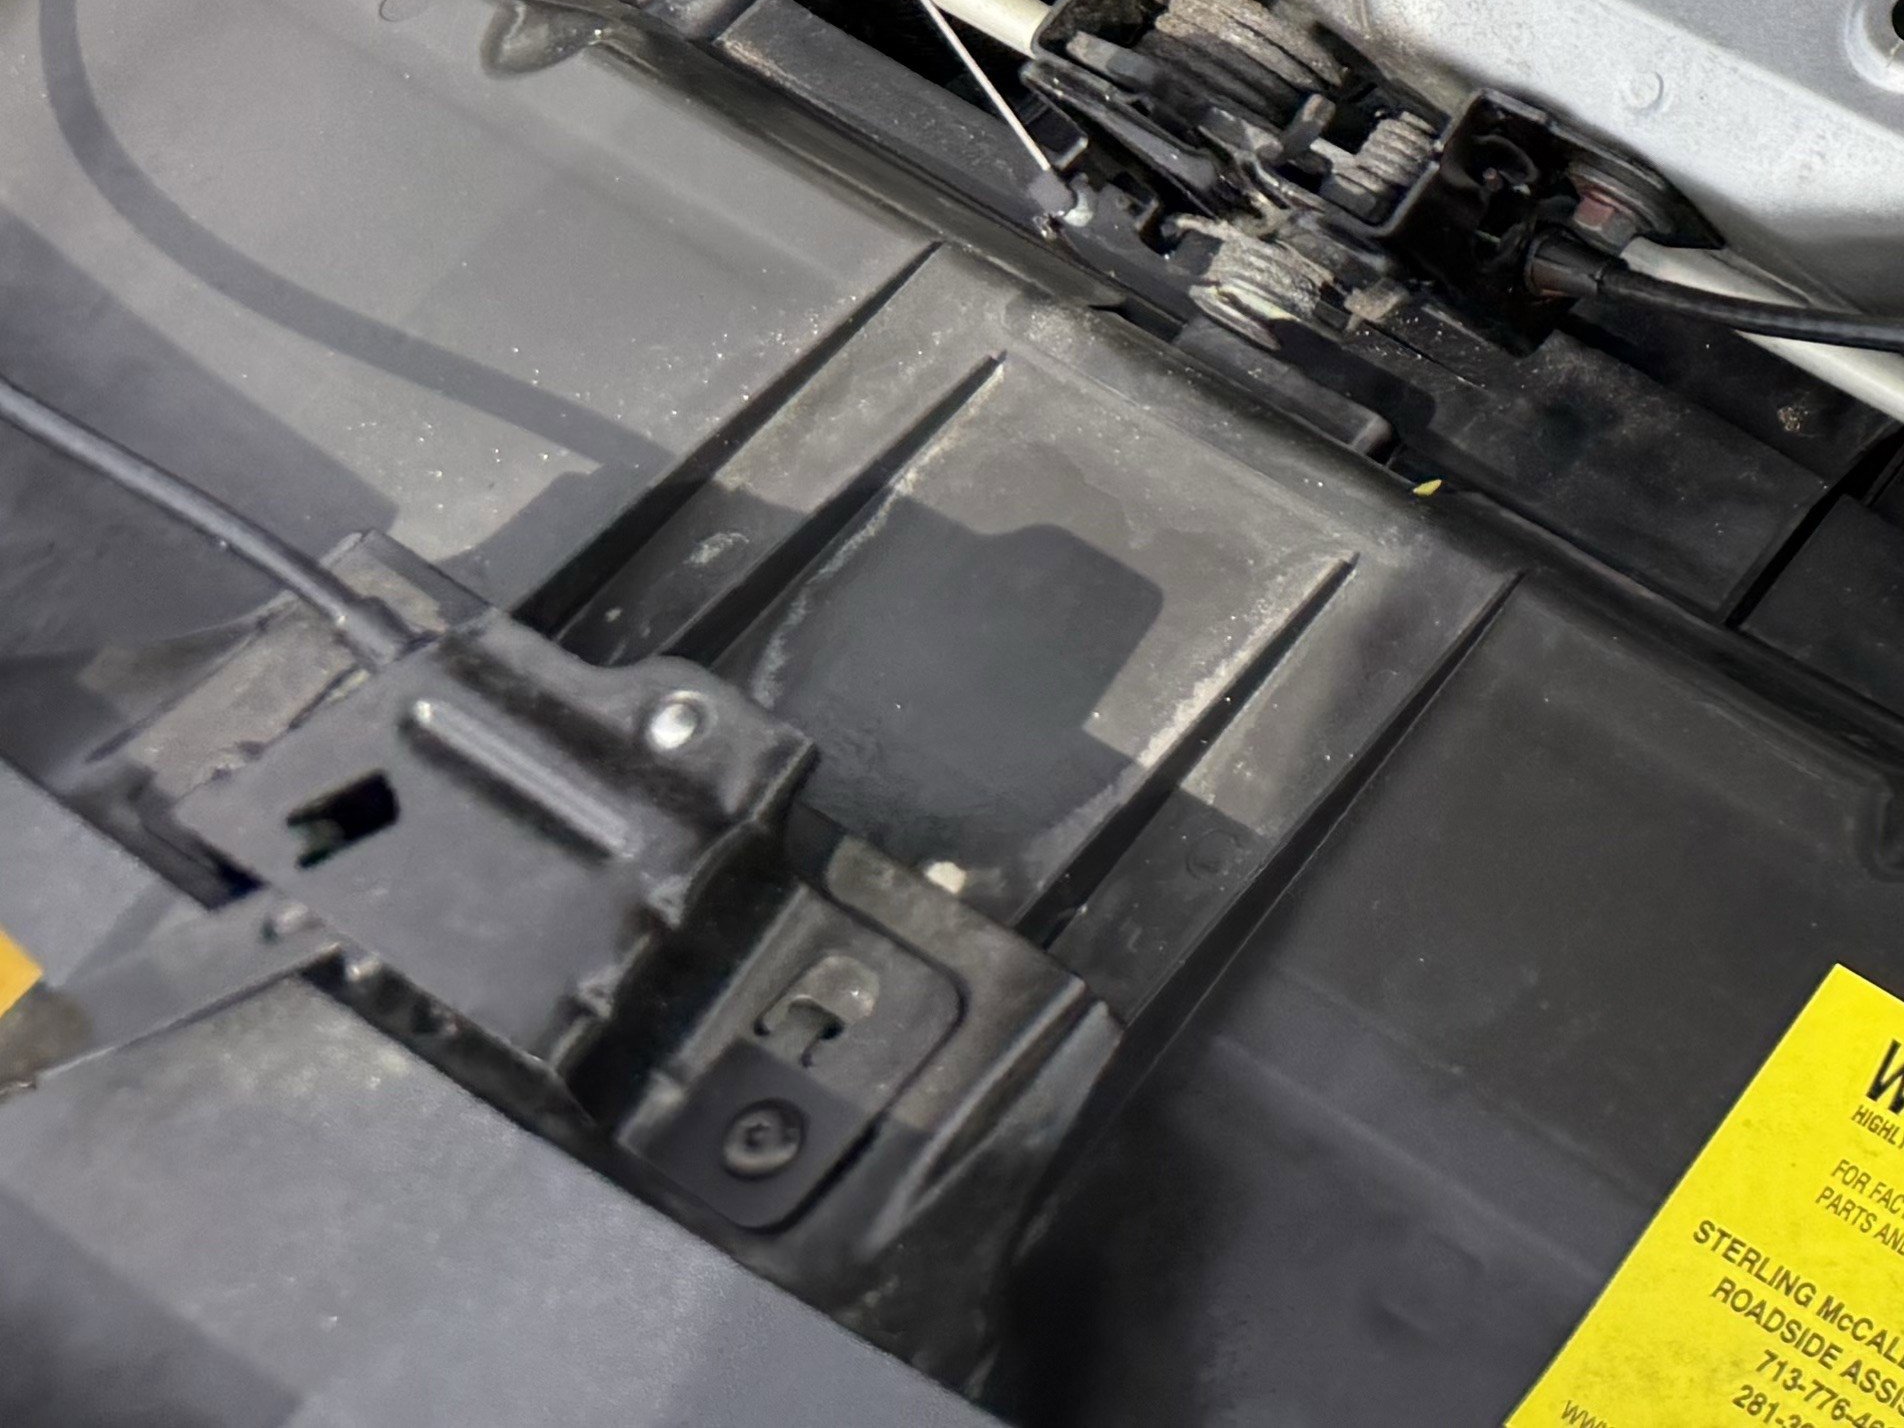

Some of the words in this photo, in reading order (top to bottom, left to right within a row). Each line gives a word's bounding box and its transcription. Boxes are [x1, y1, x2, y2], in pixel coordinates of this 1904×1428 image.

[1830, 1158, 1869, 1191] FOR
[1815, 1187, 1876, 1233] PARTS
[1692, 1219, 1817, 1306] STERLING
[1710, 1277, 1843, 1370] ROADSIDE
